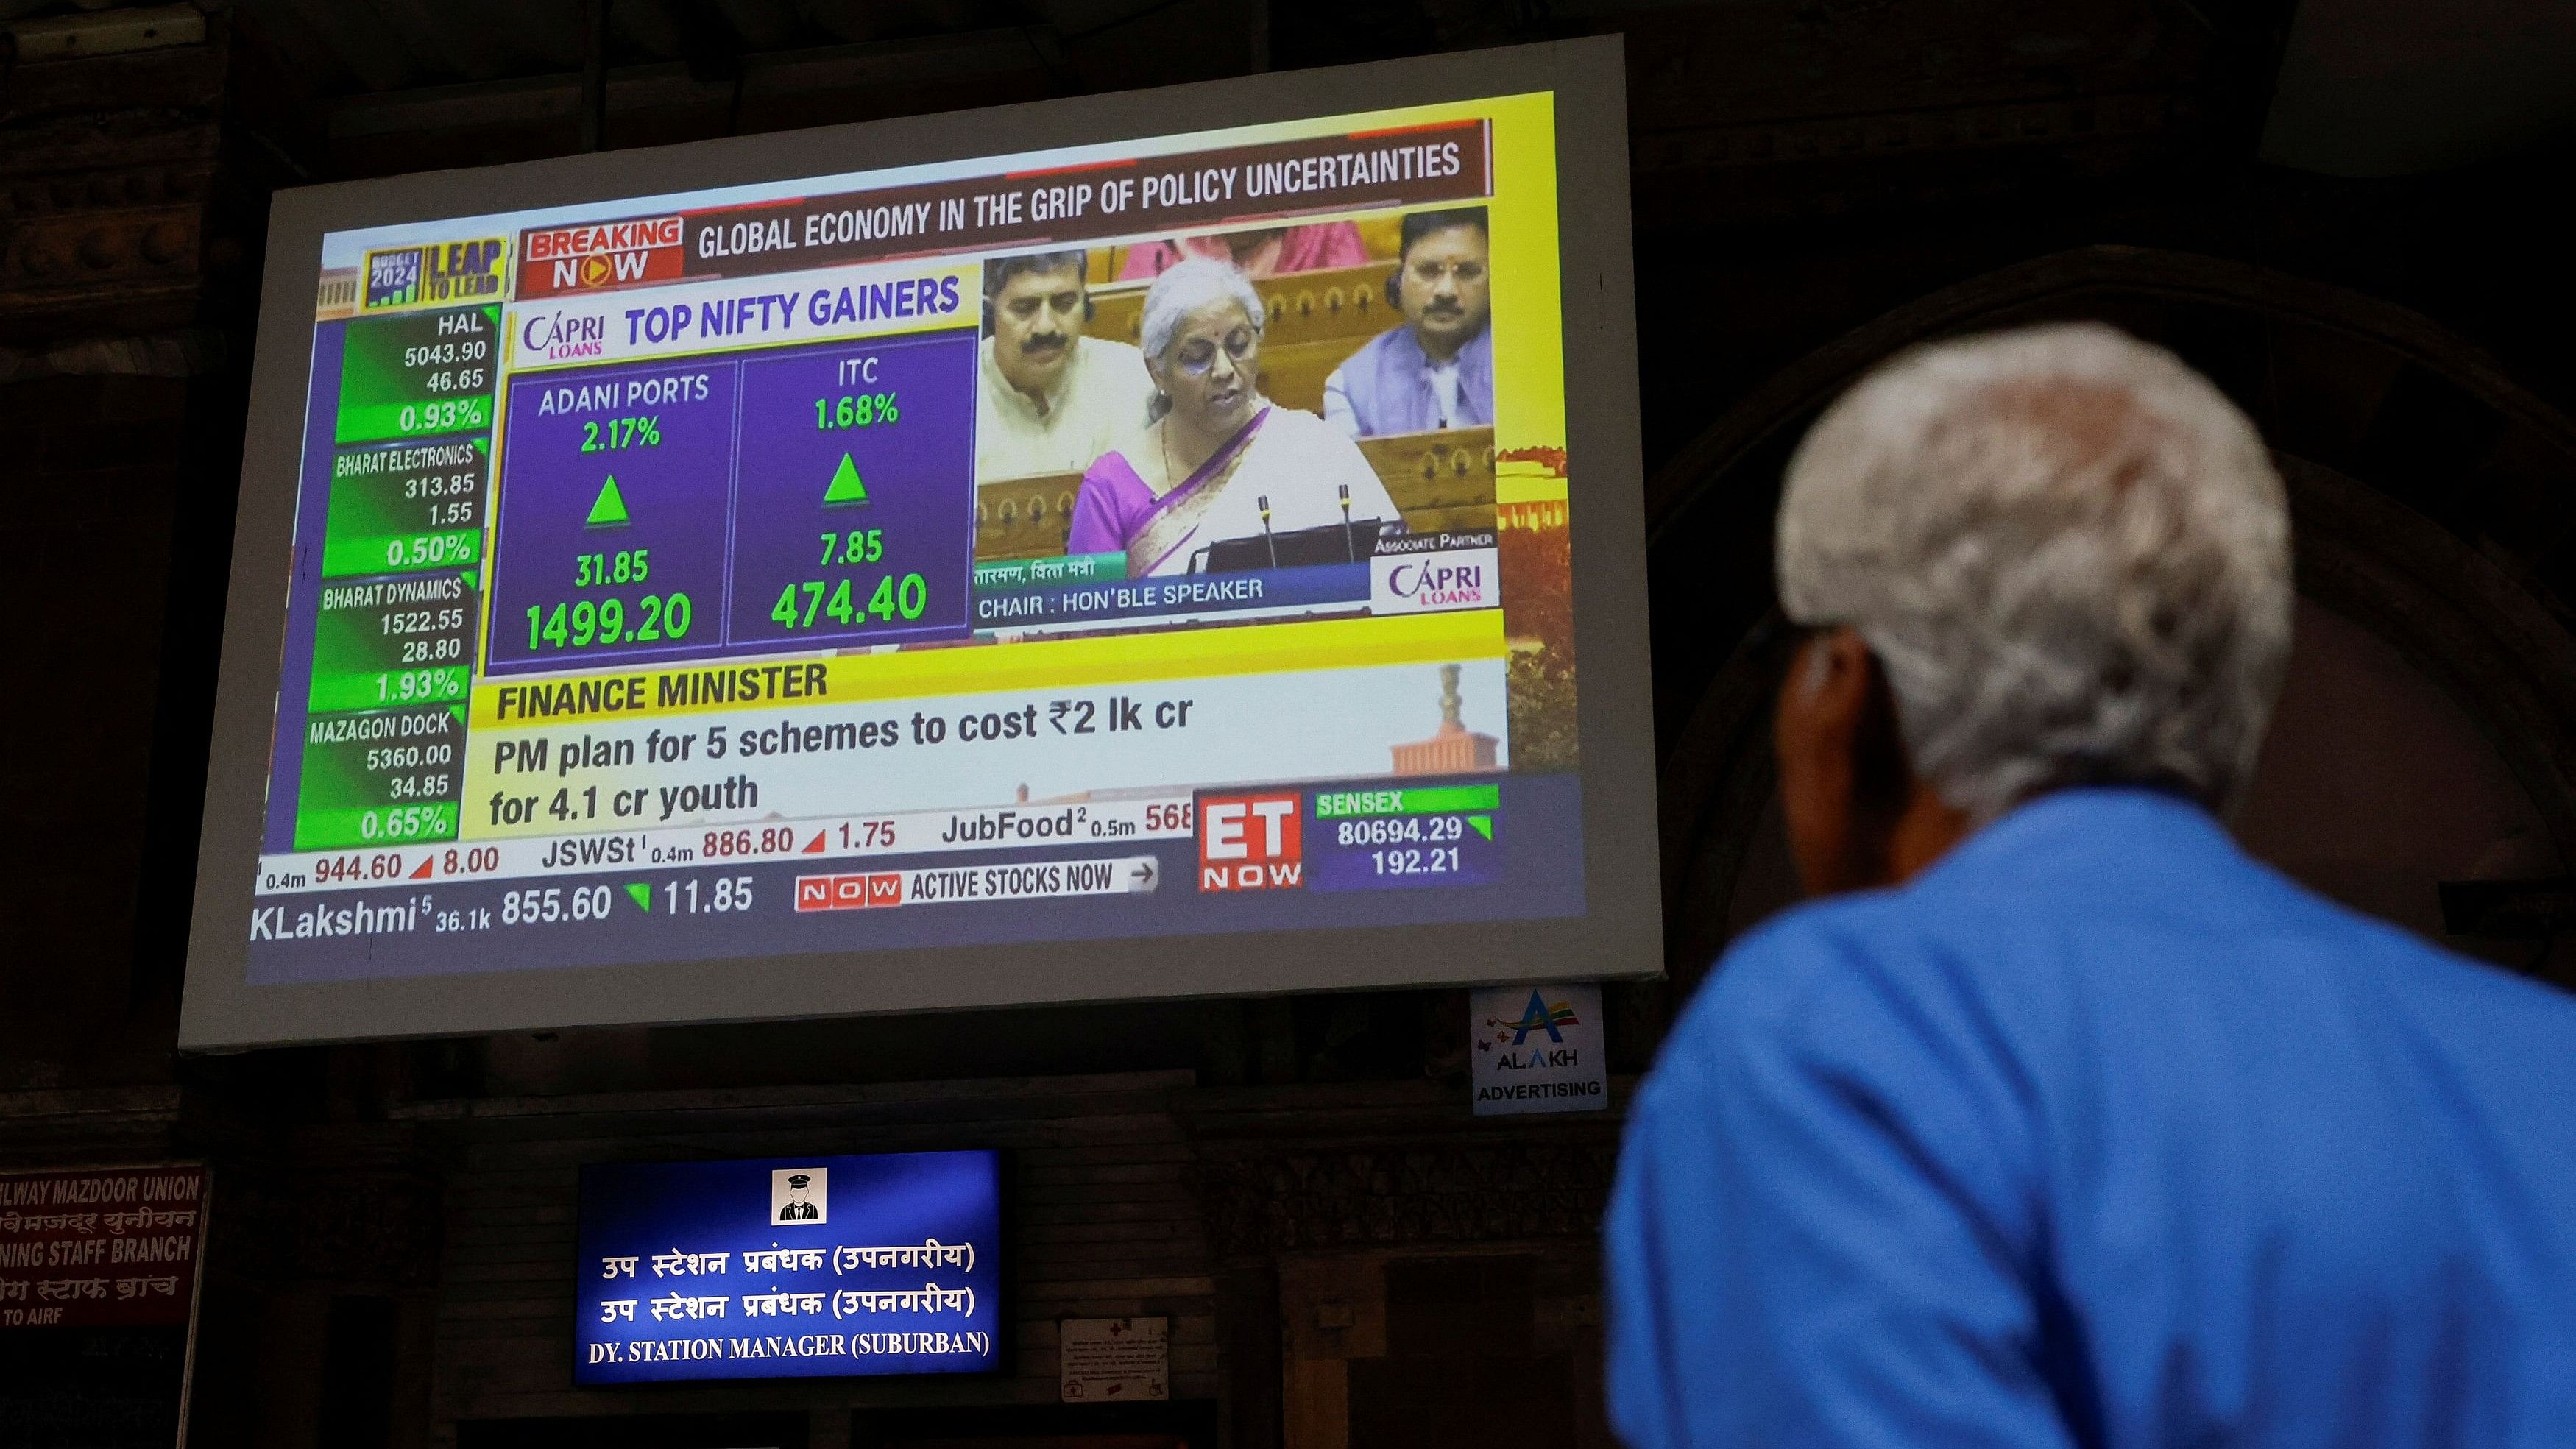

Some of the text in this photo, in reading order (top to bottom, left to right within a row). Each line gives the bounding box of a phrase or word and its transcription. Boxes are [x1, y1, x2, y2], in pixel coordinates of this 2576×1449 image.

[698, 141, 1460, 258] GLOBAL ECONOMY IN THE GRIP OF POLICY UNCERTAINTIES
[531, 220, 678, 255] BREAKING
[431, 240, 501, 277] LEAP
[371, 266, 418, 288] 2024
[437, 312, 484, 336] HAL
[626, 275, 959, 346] TOP NIFTY GAINERS
[404, 341, 486, 367] 5043.90
[549, 342, 601, 360] LOANS
[427, 369, 484, 392] 46.65
[839, 357, 878, 386] ITC
[538, 375, 709, 416] ADANI PORTS
[815, 392, 900, 431] 1.68%
[400, 398, 482, 431] 0.93%
[581, 416, 660, 452] 2.17%
[336, 443, 473, 478] BHARAT ELECTRONICS
[405, 473, 475, 500] 313.85
[431, 502, 473, 525] 1.55
[387, 534, 471, 567] 0.50%
[820, 528, 883, 566] 7.85
[575, 549, 649, 587] 31.85
[323, 578, 461, 610] BHARAT DYNAMICS
[771, 573, 927, 629] 474.40
[978, 595, 1044, 619] CHAIR
[1062, 585, 1156, 612] HON'BLE
[1163, 578, 1263, 605] SPEAKER
[1420, 589, 1481, 606] LOANS
[381, 608, 463, 635] 1522.55
[526, 592, 693, 651] 1499.20
[403, 637, 461, 664] 28.80
[376, 670, 459, 702] 1.93%
[498, 663, 828, 720] FINANCE MINISTER
[310, 712, 450, 745] MAZAGON DOCK
[494, 694, 1194, 778] PM plan for 5 schemes to cost ₹2 lk cr
[367, 744, 452, 770] 5360.00
[390, 774, 449, 799] 34.85
[489, 774, 758, 826] for 4.1 cr youth
[1317, 791, 1403, 815] SENSEX
[361, 807, 447, 838] 0.65%
[1206, 801, 1294, 860] ET
[1337, 815, 1462, 845] 80694.29
[266, 874, 305, 890] 0.4m
[316, 854, 402, 883] 944.60
[443, 846, 499, 874] 8.00
[651, 846, 693, 864] 0.4m
[703, 827, 793, 857] 886.80
[839, 821, 896, 849] 1.75
[1091, 819, 1136, 837] 0.5m
[1372, 846, 1459, 875] 192.21
[803, 862, 1112, 901] NOW ACTIVE STOCKS NOW
[1203, 863, 1302, 889] NOW
[436, 909, 491, 932] 36.1k
[502, 885, 612, 925] 855.60
[664, 876, 753, 915] 11.85
[1497, 1049, 1578, 1071] ALAKH
[1477, 1081, 1601, 1101] ADVERTISING
[52, 1177, 138, 1205] MAZDOOR
[143, 1175, 199, 1201] UNION
[48, 1239, 107, 1266] STAFF
[111, 1236, 191, 1264] BRANCH
[602, 1238, 975, 1280] उप स्टेशन प्रबंधक (उपनगरीय)
[4, 1307, 63, 1325] TO AIRF
[601, 1282, 975, 1323] उप स्टेशन प्रबंधक (उपनगरीय)
[589, 1331, 989, 1364] DY. STATION MANAGER (SUBURBAN)
